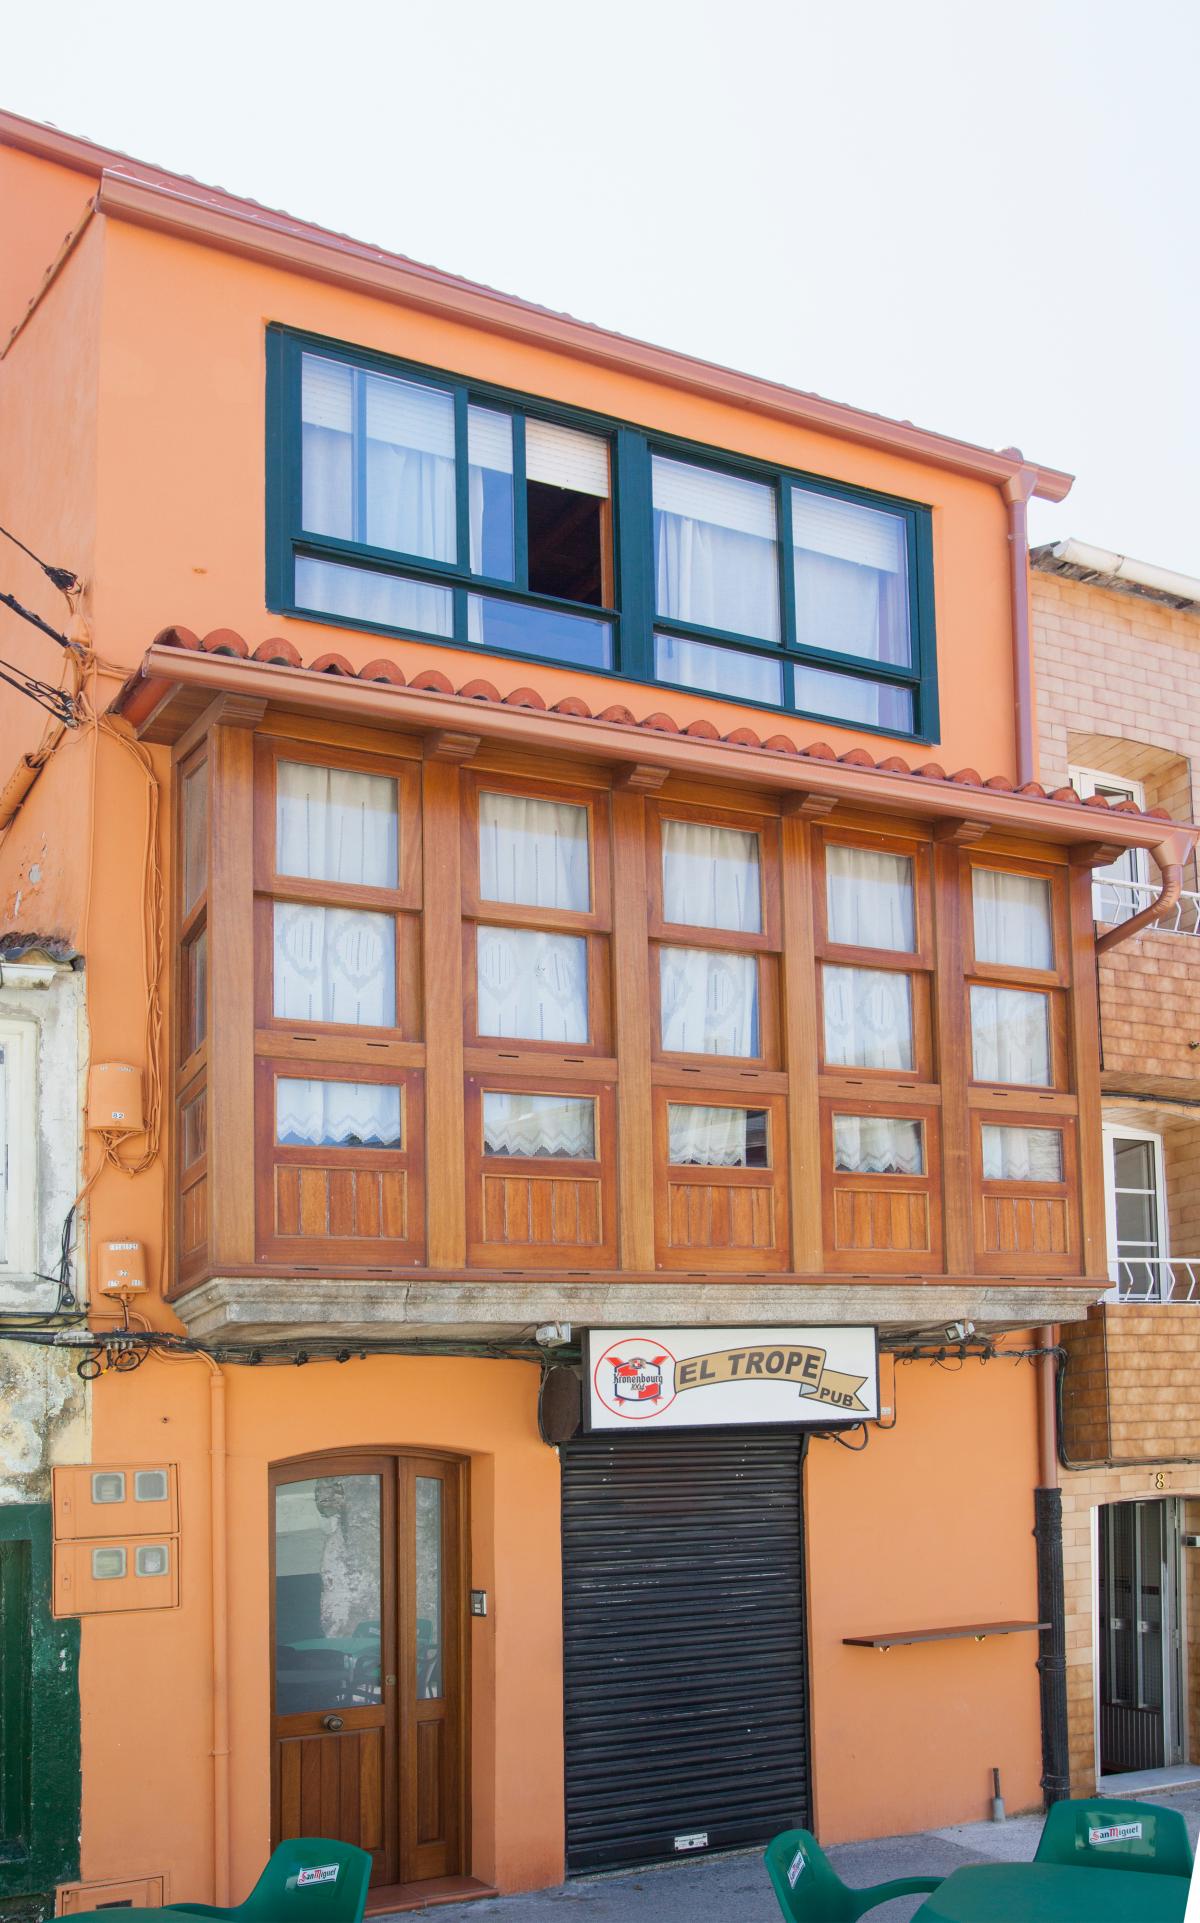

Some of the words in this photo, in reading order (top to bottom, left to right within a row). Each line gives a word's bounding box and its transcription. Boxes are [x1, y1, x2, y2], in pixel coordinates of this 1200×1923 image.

[680, 1359, 716, 1385] EL
[728, 1351, 821, 1379] TROPE
[613, 1373, 663, 1384] Kronenbourg
[820, 1387, 853, 1407] PUB
[1155, 1472, 1165, 1489] 8
